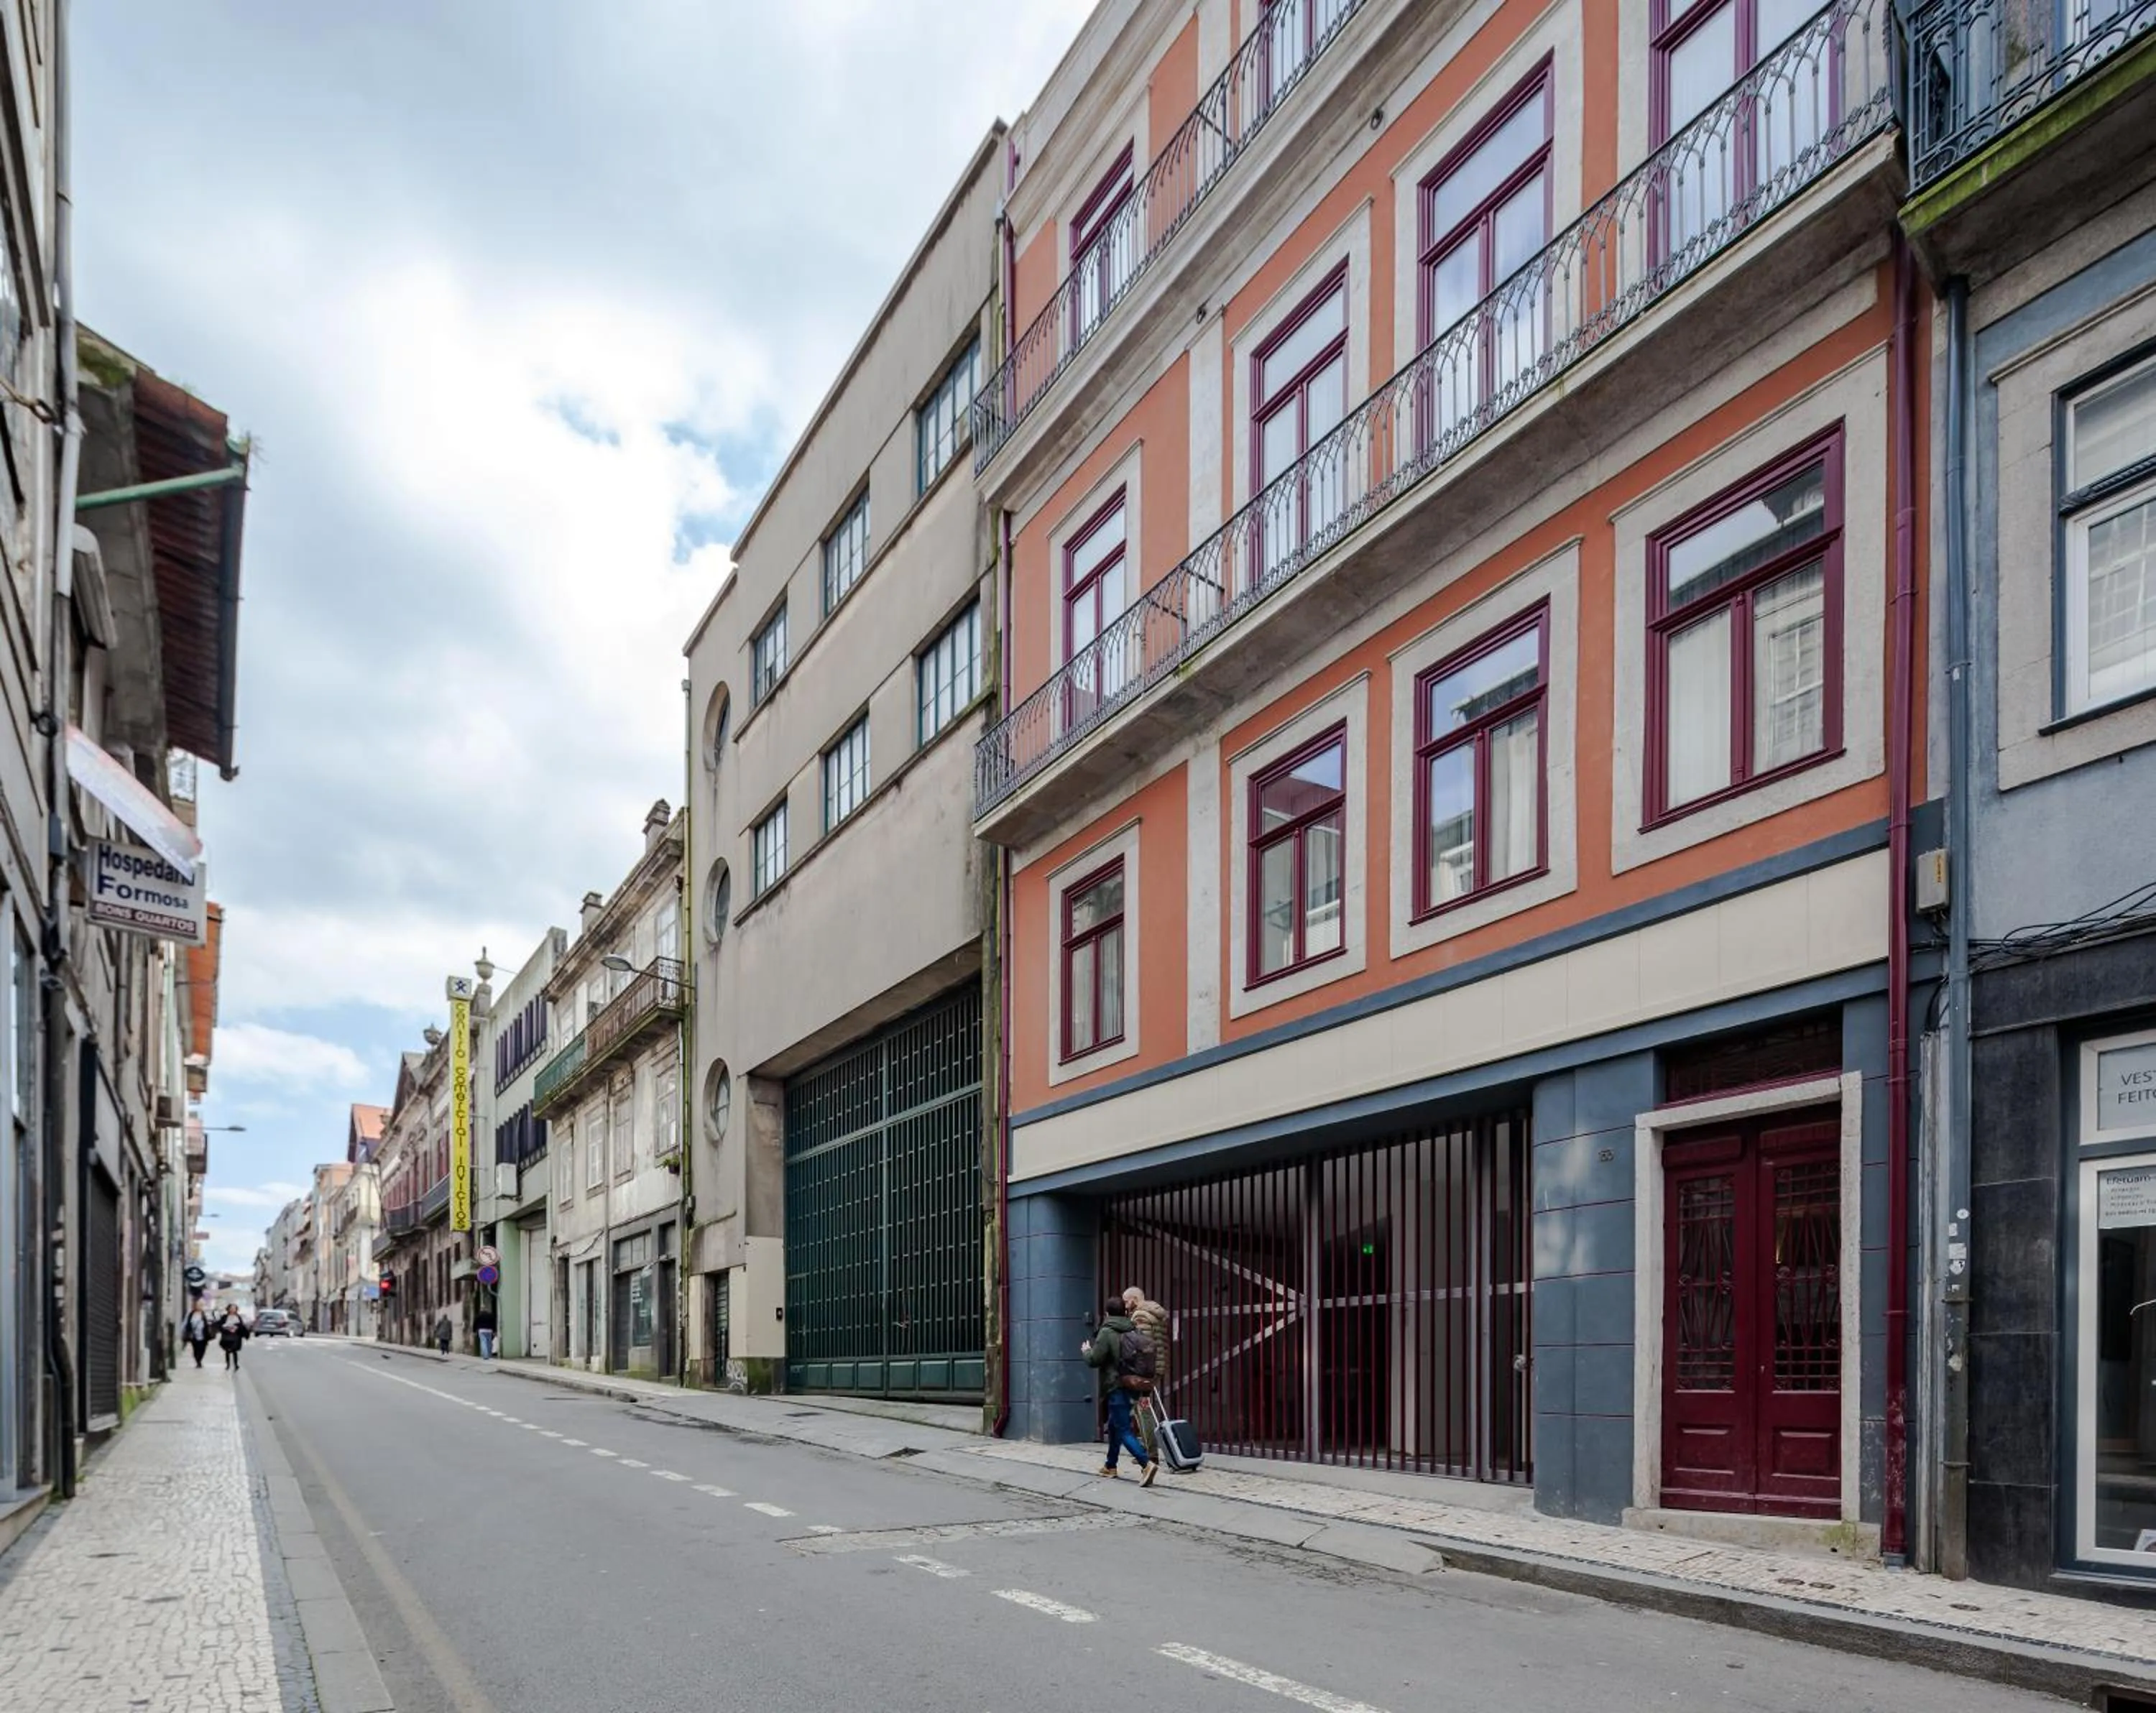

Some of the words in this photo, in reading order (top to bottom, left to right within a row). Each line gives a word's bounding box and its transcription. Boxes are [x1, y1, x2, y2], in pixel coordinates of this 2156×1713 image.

[97, 873, 188, 909] Formosa
[95, 902, 132, 920] BONS
[134, 911, 195, 932] QUARTOS
